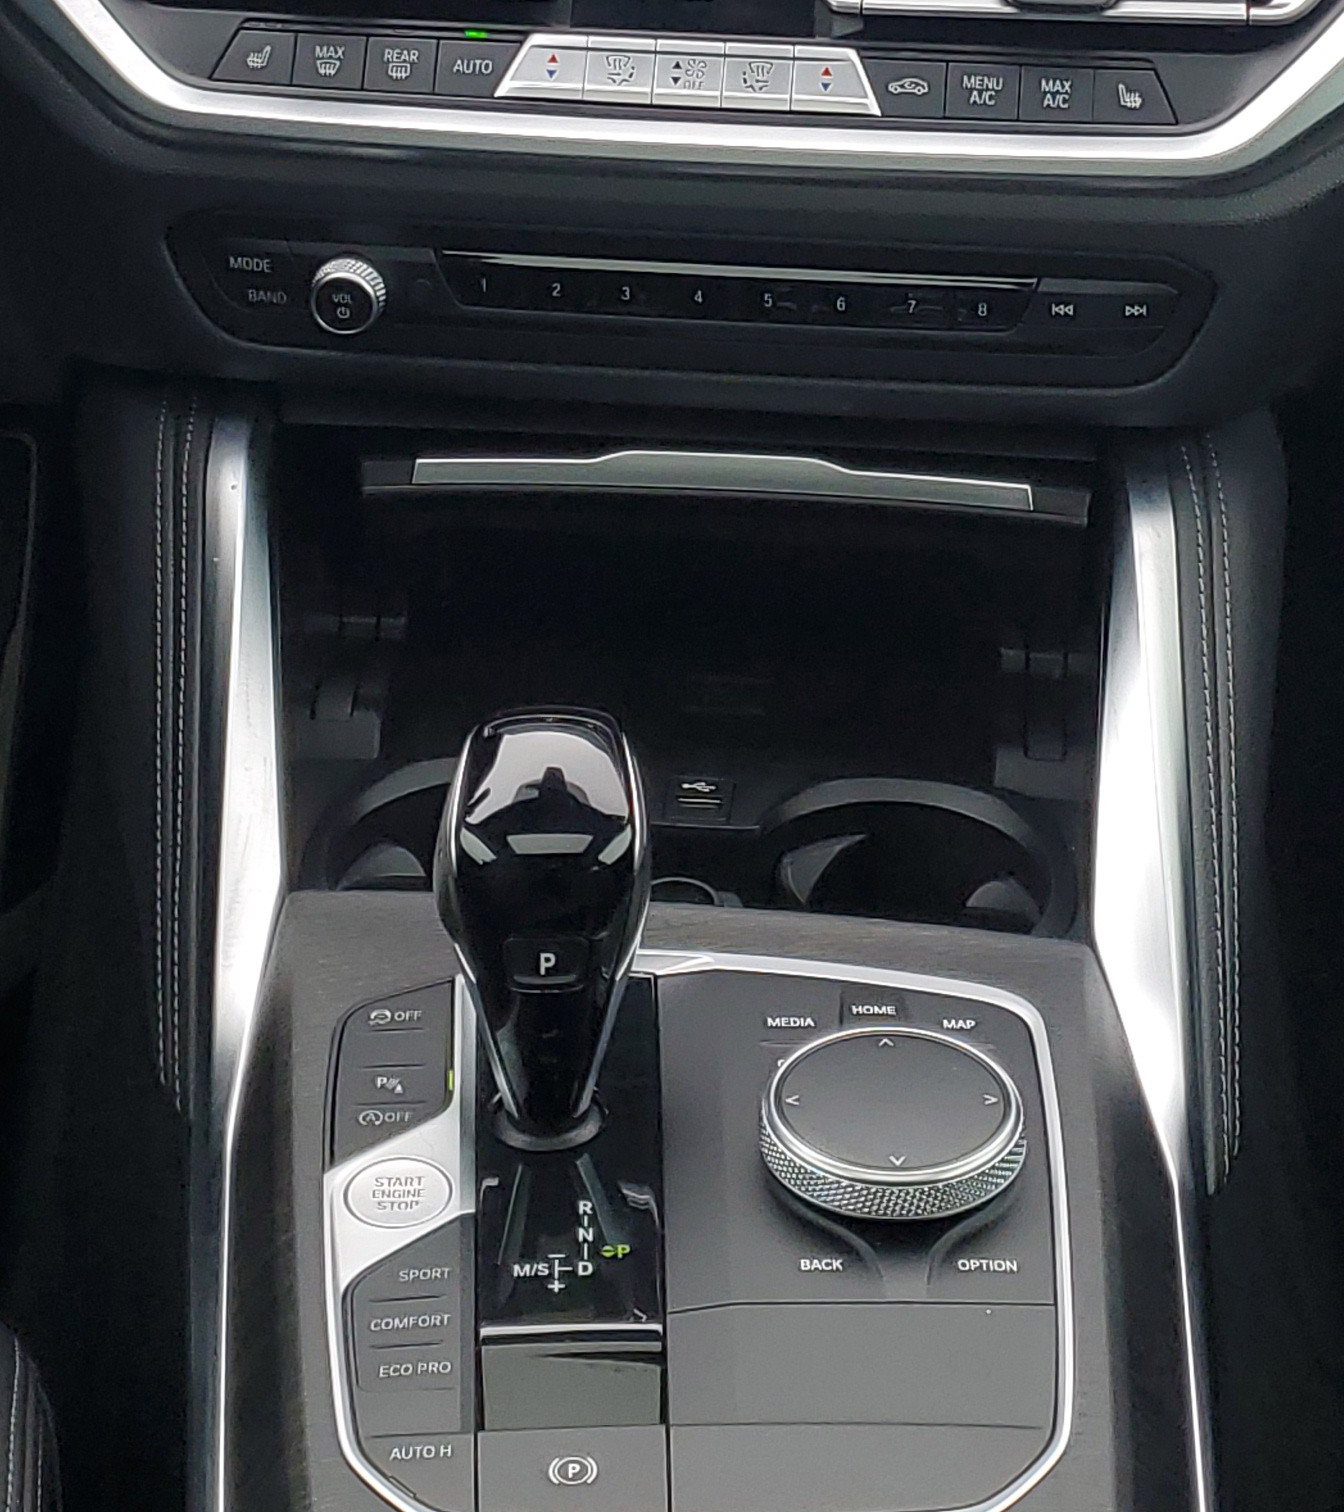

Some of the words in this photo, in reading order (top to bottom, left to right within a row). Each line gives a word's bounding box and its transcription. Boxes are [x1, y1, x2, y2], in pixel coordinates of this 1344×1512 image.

[315, 44, 345, 60] MAX
[384, 48, 419, 64] REAR
[452, 58, 493, 75] AUTO
[962, 75, 1003, 91] MENU
[1041, 79, 1072, 94] MAX
[969, 92, 996, 106] A/C
[1043, 94, 1070, 109] A/C
[229, 256, 272, 274] MODE
[248, 288, 288, 305] BAND
[550, 282, 562, 298] 2
[620, 285, 631, 301] 3
[693, 288, 704, 304] 4
[762, 293, 773, 308] 5
[835, 296, 846, 311] 6
[907, 299, 917, 315] 7
[977, 302, 988, 318] 8
[539, 951, 556, 977] P
[394, 1009, 423, 1023] OFF
[851, 1004, 897, 1016] HOME
[767, 1016, 815, 1028] MEDIA
[942, 1019, 976, 1030] MAP
[384, 1110, 413, 1124] OFF
[373, 1175, 426, 1188] START
[371, 1188, 426, 1200] ENGINE
[376, 1199, 420, 1211] STOP
[578, 1200, 593, 1216] R
[578, 1227, 593, 1243] N
[617, 1243, 631, 1258] P
[513, 1262, 550, 1278] M/S
[577, 1261, 593, 1276] D
[800, 1257, 844, 1272] BACK
[957, 1258, 1018, 1273] OPTION
[398, 1266, 451, 1283] SPORT
[369, 1313, 452, 1331] COMFORT
[378, 1363, 413, 1379] ECO
[417, 1360, 452, 1376] PRO
[388, 1445, 436, 1462] AUTO
[439, 1444, 453, 1459] H
